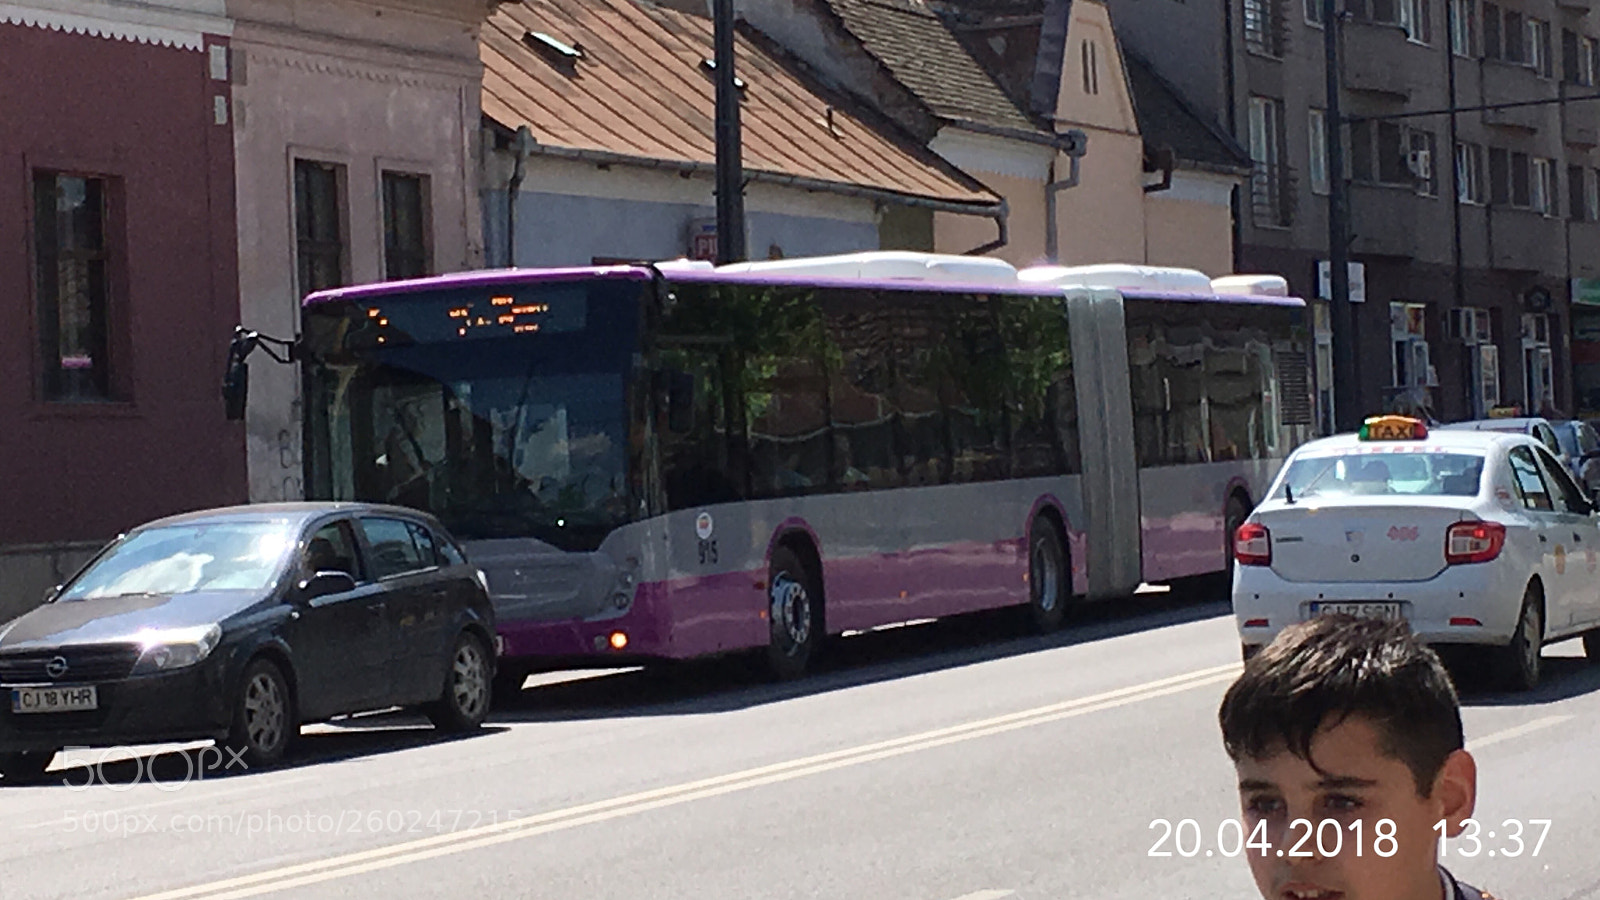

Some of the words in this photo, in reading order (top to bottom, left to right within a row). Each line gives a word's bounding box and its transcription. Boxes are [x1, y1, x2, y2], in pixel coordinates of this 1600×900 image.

[1371, 424, 1414, 439] TAXI
[698, 540, 718, 564] 915
[23, 692, 40, 708] CJ
[44, 691, 57, 706] 18
[61, 689, 92, 704] YHR
